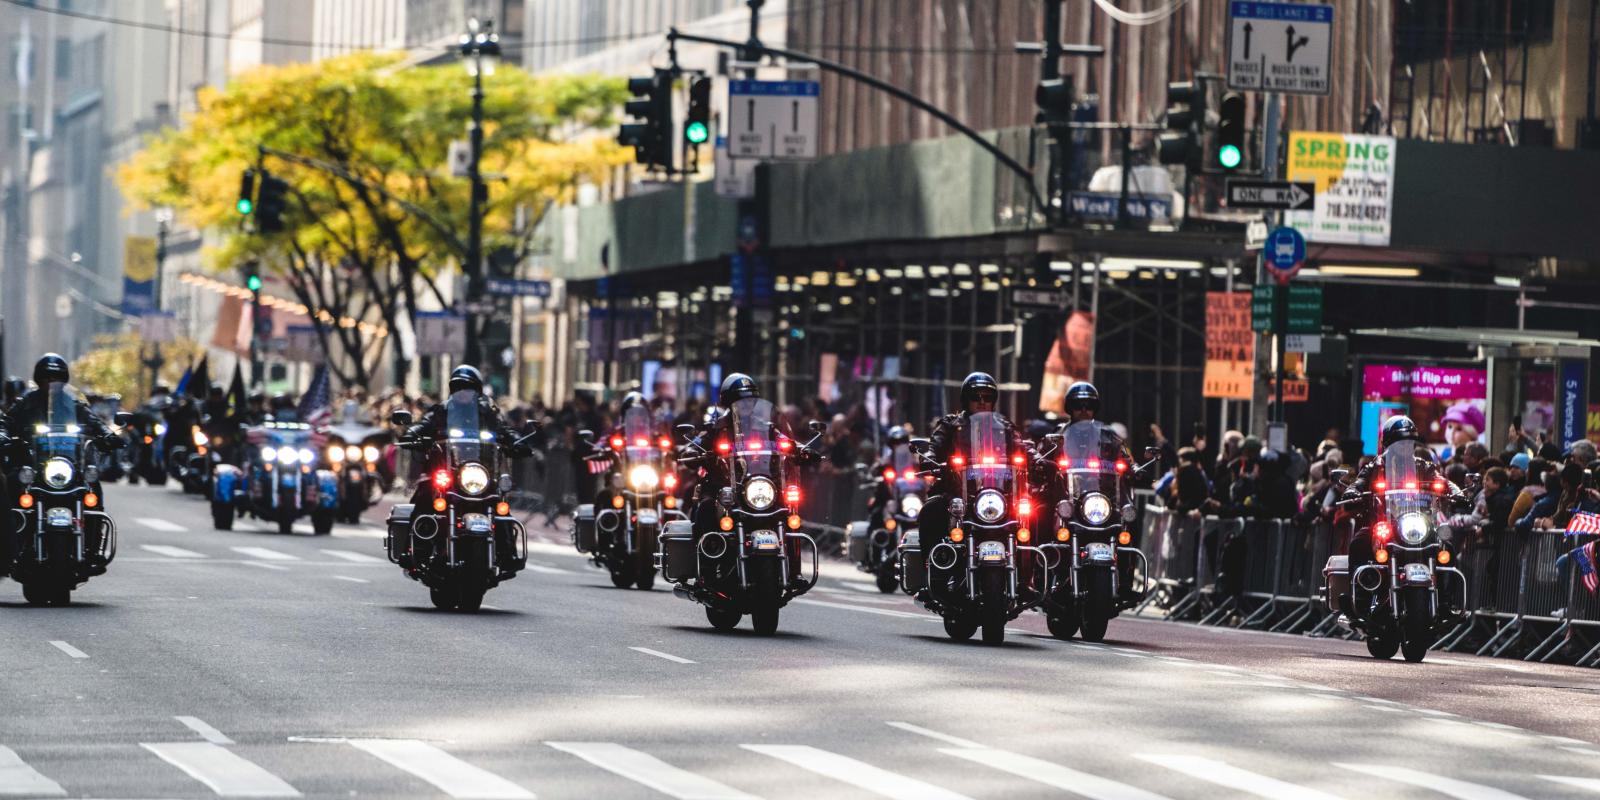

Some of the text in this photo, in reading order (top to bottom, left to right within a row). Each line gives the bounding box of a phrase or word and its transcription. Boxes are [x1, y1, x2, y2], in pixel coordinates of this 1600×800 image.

[1234, 62, 1259, 73] BUSES
[1271, 64, 1320, 76] BUSES ONLY
[1235, 76, 1255, 86] ONLY
[1275, 79, 1297, 88] RIGHT
[1300, 81, 1325, 90] TURNS
[1295, 140, 1389, 161] SPRING
[1295, 160, 1368, 171] SCAFFOLDING
[1240, 189, 1301, 202] ONE WAY
[1073, 197, 1111, 213] West
[1206, 330, 1253, 345] CLOSED
[1238, 348, 1253, 362] A
[1391, 370, 1462, 386] She'll flip out
[1411, 385, 1434, 395] what's
[1565, 379, 1578, 390] 5
[1564, 390, 1577, 438] Avenue
